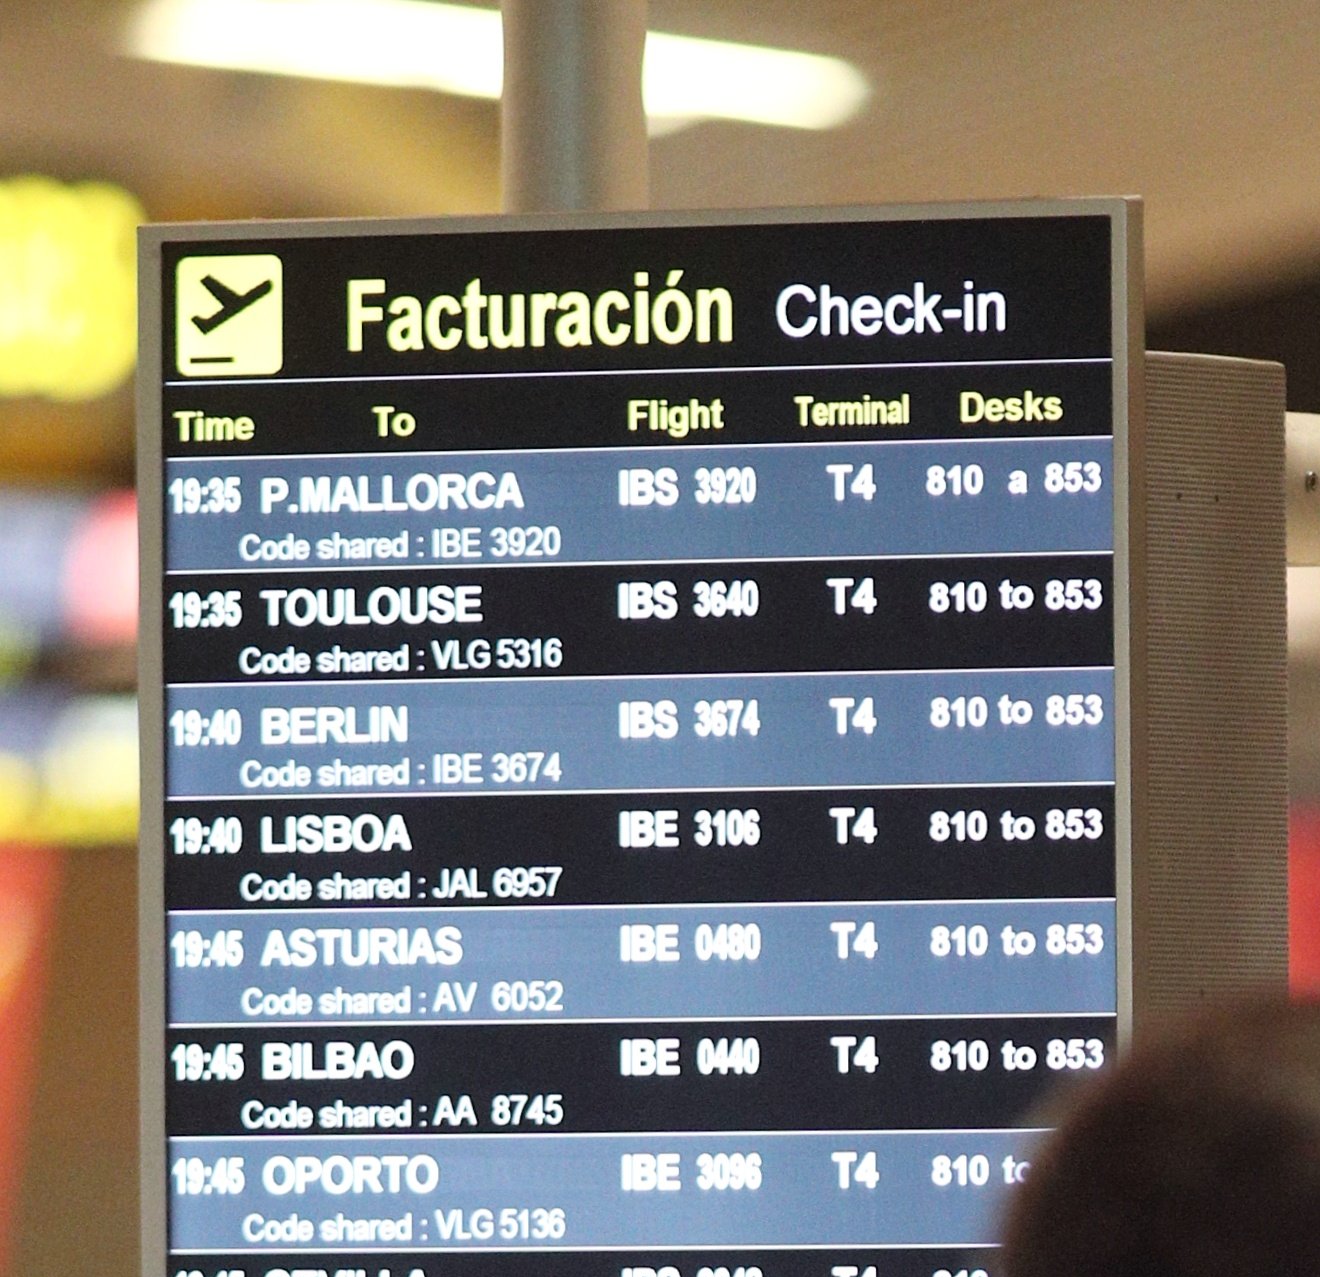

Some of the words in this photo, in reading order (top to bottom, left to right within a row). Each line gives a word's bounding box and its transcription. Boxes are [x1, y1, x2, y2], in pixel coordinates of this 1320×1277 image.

[346, 268, 734, 353] Facturación
[774, 279, 1007, 339] Check-in
[172, 410, 256, 443] Time
[370, 404, 417, 438] To
[627, 397, 725, 439] Flight
[793, 392, 911, 428] Terminal
[959, 389, 1064, 424] Desks
[167, 475, 243, 516] 19:35
[259, 470, 526, 516] P.MALLORCA
[617, 466, 681, 508] IBS
[693, 465, 758, 506] 3920
[824, 462, 878, 503] T4
[924, 463, 985, 498] 810
[1006, 469, 1029, 496] a
[1043, 460, 1103, 495] 853
[237, 531, 312, 563] Code
[314, 529, 410, 561] shared
[430, 526, 484, 560] IBE
[488, 524, 563, 560] 3920
[168, 589, 243, 629] 19:35
[258, 584, 484, 628] TOULOUSE
[617, 579, 679, 621] IBS
[692, 579, 760, 618] 3640
[168, 707, 243, 748] 19:40
[259, 704, 409, 746] BERLIN
[617, 698, 680, 741] IBS
[692, 698, 762, 739] 3674
[169, 816, 243, 855] 19:40
[260, 813, 413, 855] LISBOA
[618, 809, 680, 849] IBE
[693, 808, 761, 848] 3106
[169, 928, 245, 969] 19:45
[258, 925, 465, 969] ASTURIAS
[618, 923, 682, 964] IBE
[693, 922, 763, 963] 0480
[170, 1042, 246, 1082] 19:45
[261, 1039, 415, 1081] BILBAO
[619, 1037, 682, 1077] IBE
[696, 1036, 761, 1076] 0440
[170, 1156, 247, 1197] 19:45
[260, 1153, 440, 1197] OPORTO
[619, 1152, 683, 1193] IBE
[694, 1151, 764, 1192] 3096
